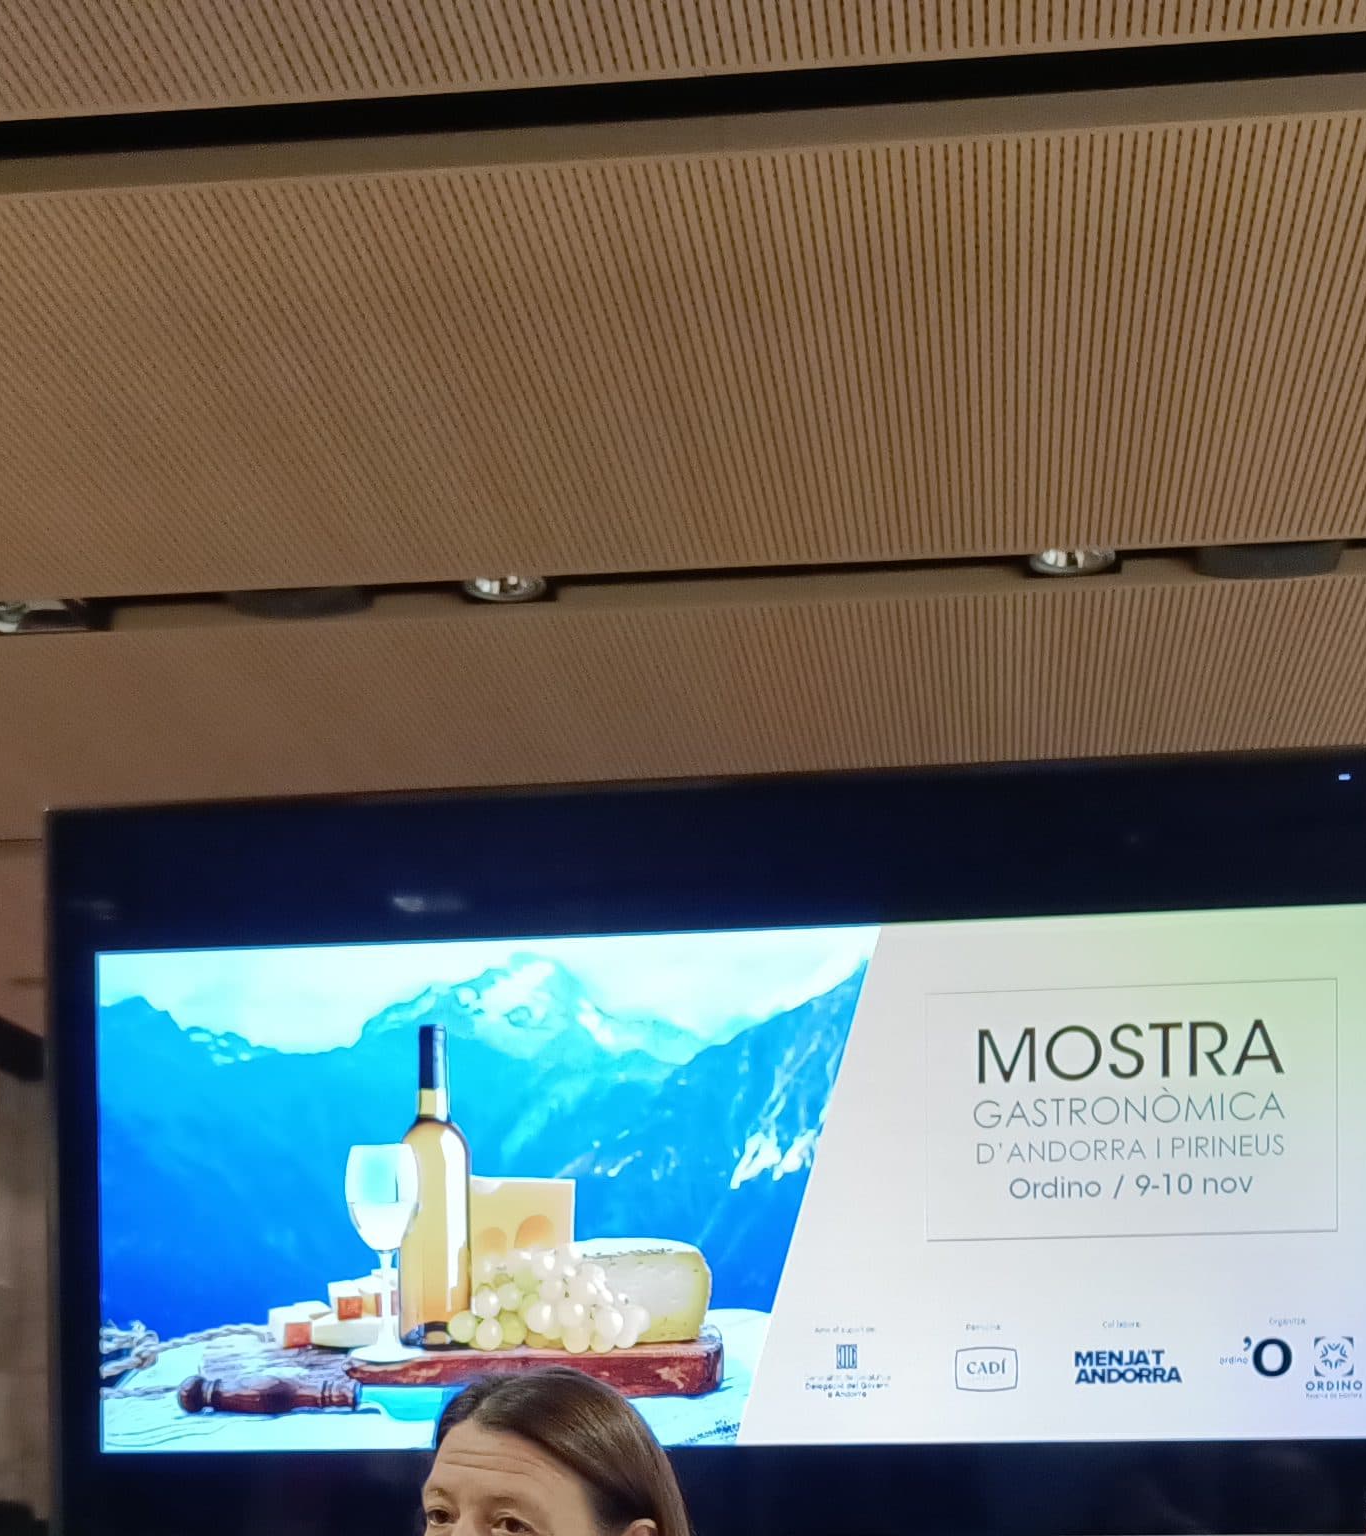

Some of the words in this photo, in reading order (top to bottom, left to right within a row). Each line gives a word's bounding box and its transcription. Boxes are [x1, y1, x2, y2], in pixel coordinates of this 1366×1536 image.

[977, 1019, 1285, 1083] MOSTRA
[973, 1087, 1285, 1129] GASTRONÒMICA
[976, 1138, 1146, 1164] D'ANDORRA
[1155, 1138, 1161, 1159] I
[1171, 1134, 1285, 1160] PIRINEUS
[1009, 1177, 1101, 1199] Ordino
[1135, 1172, 1193, 1196] 9-10
[1202, 1173, 1253, 1195] nov
[966, 1357, 1007, 1375] CADÍ
[1074, 1366, 1182, 1385] ANDORRA
[1305, 1380, 1363, 1391] ORDINO
